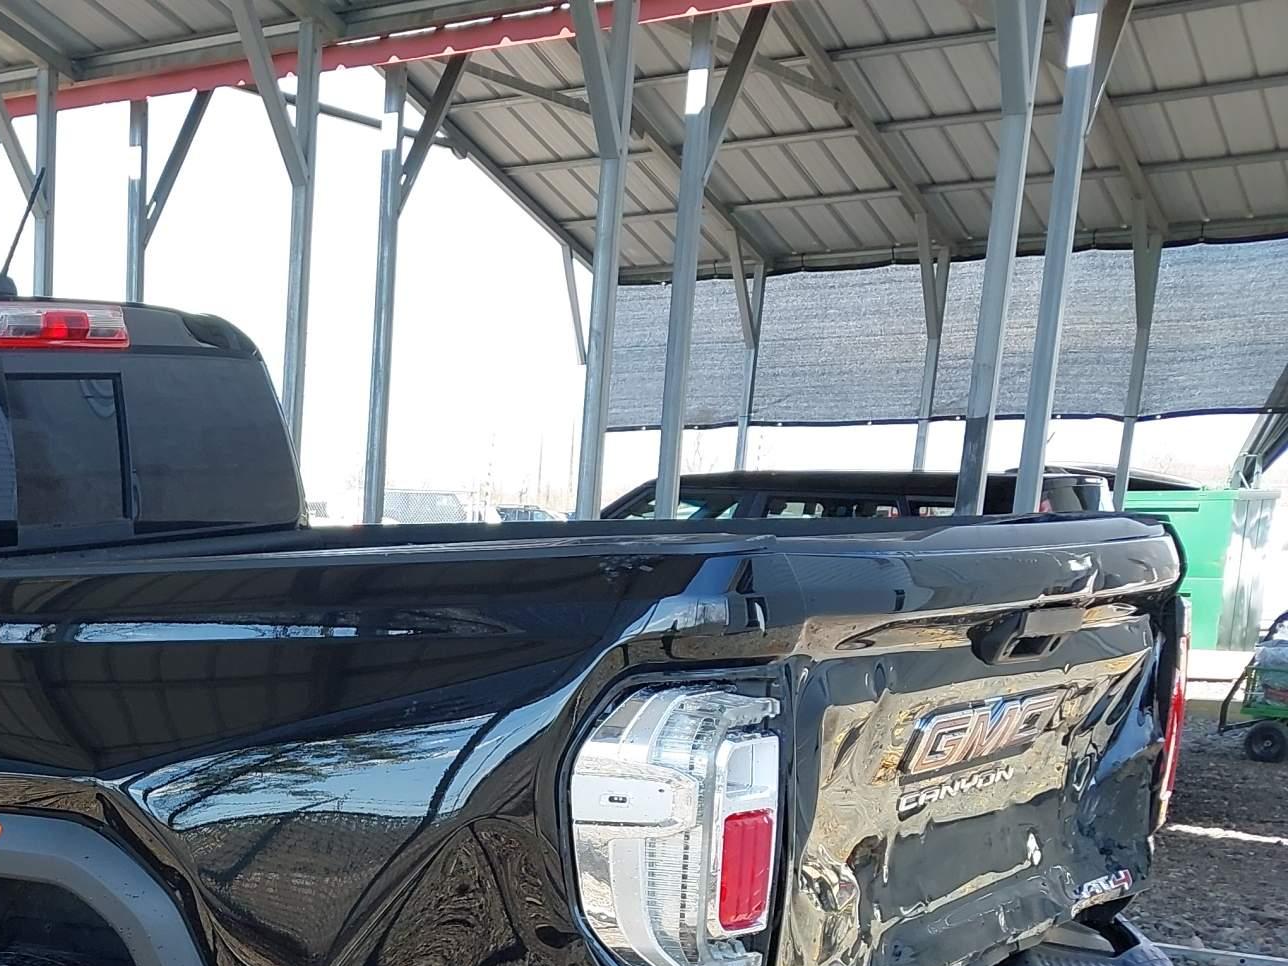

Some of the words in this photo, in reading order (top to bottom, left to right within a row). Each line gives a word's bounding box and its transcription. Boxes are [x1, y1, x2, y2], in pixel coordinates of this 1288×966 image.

[911, 693, 1059, 775] GMC
[898, 766, 1014, 812] CANYON
[1082, 869, 1132, 898] AT4
